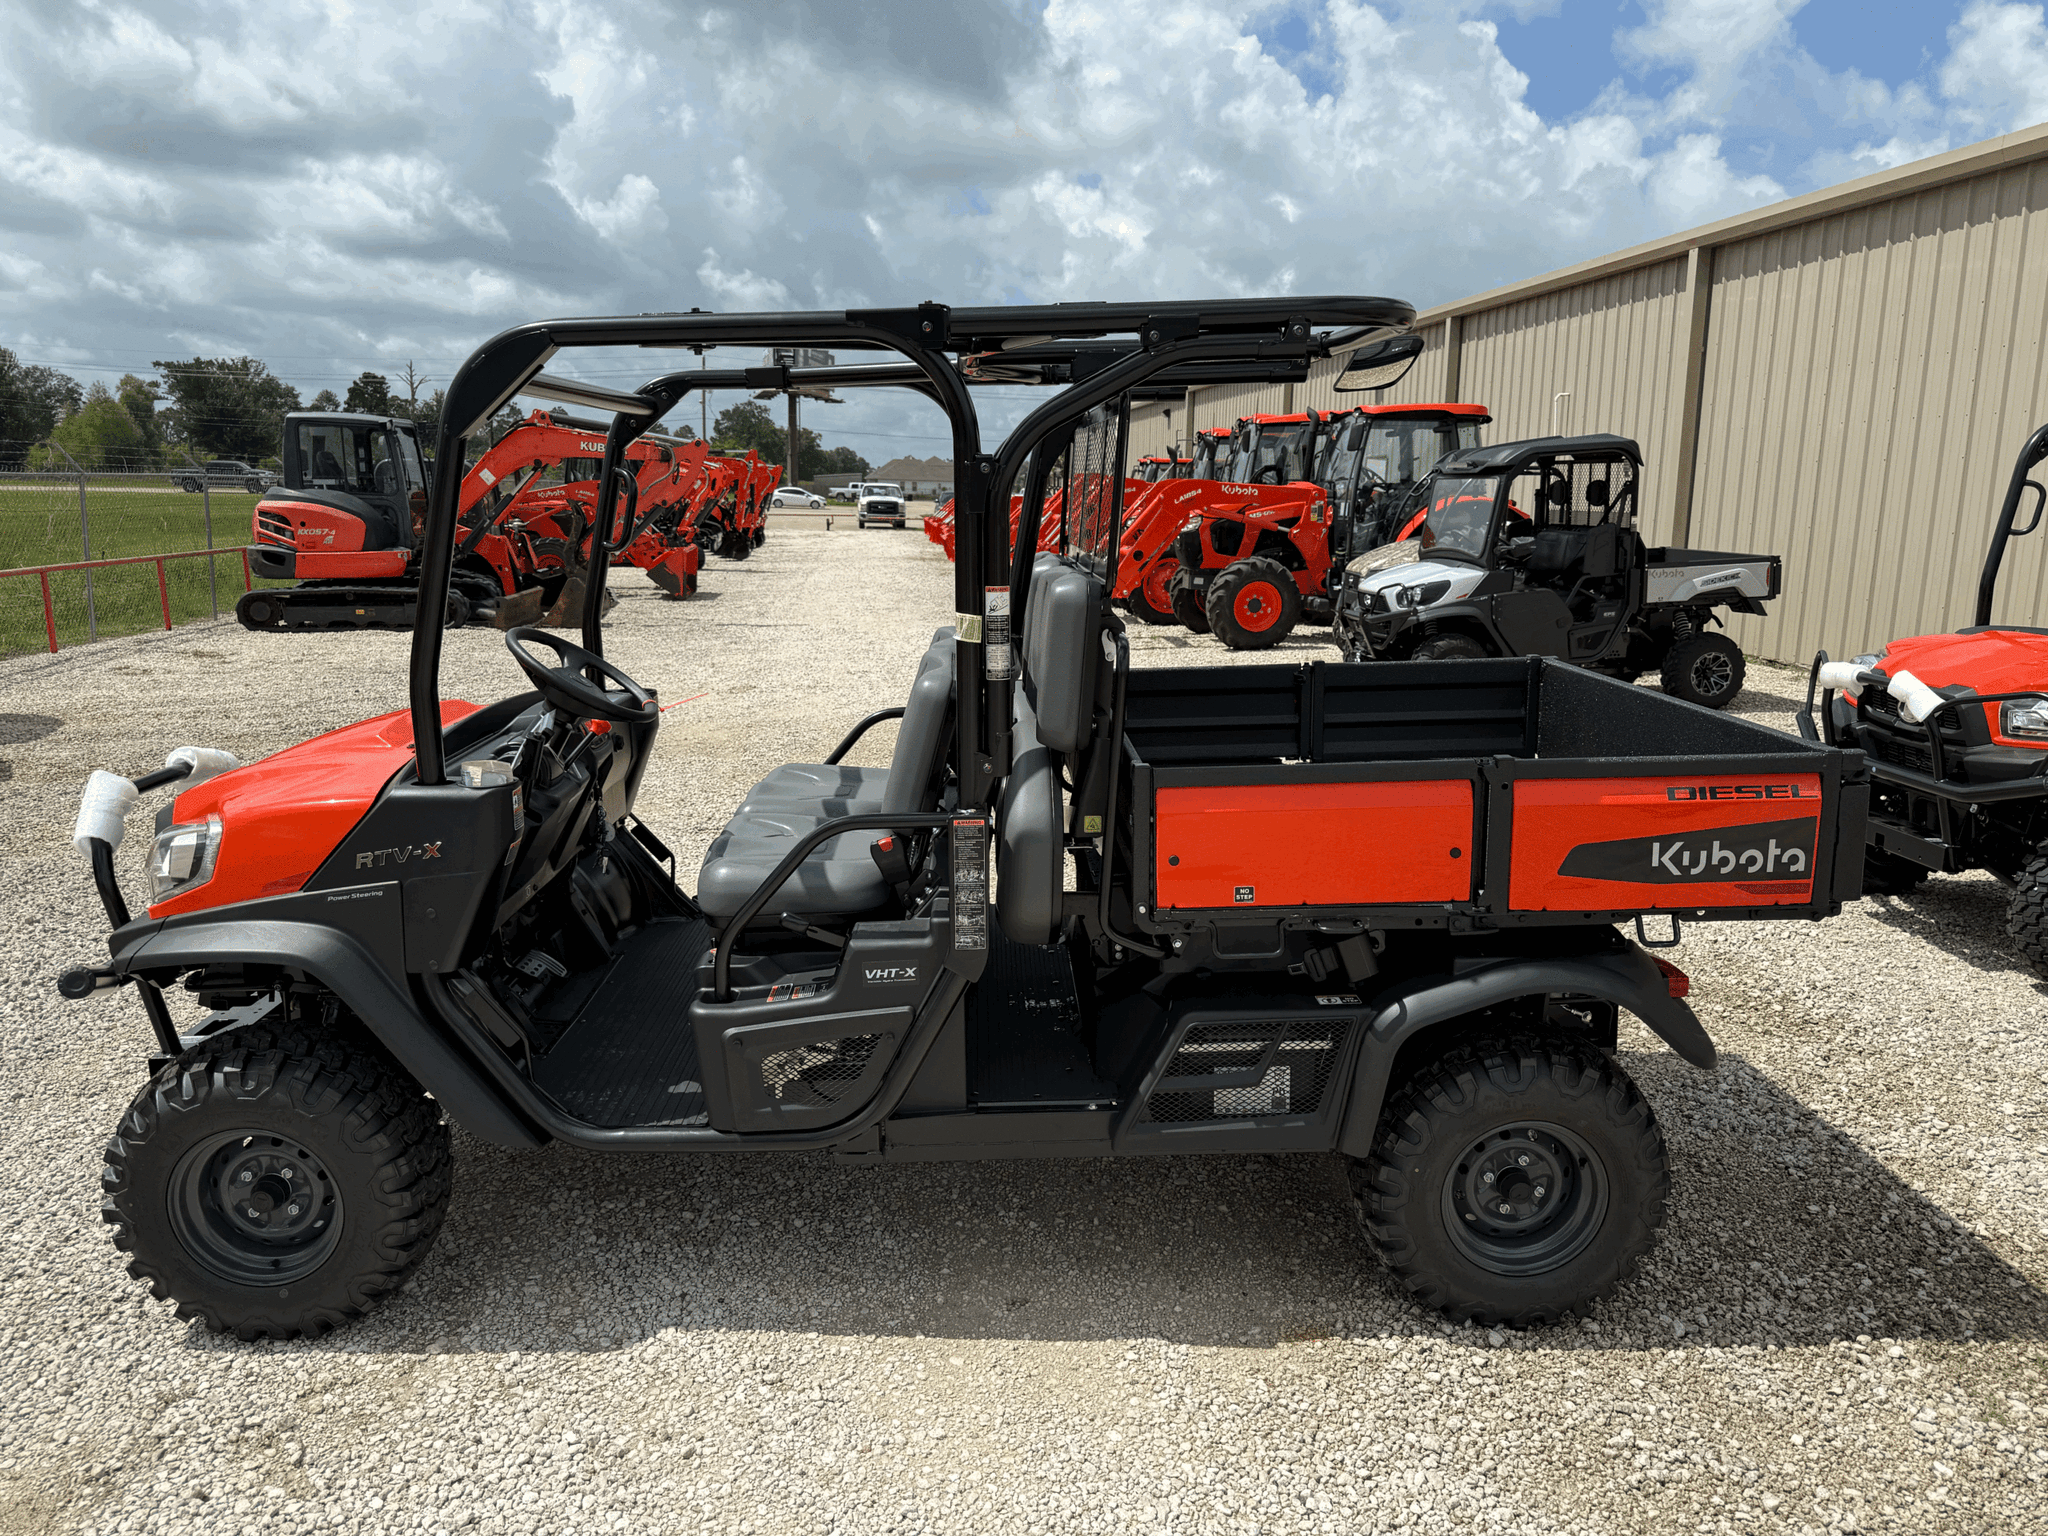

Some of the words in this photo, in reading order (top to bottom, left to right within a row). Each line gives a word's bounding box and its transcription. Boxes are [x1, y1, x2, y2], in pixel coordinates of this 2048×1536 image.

[580, 441, 606, 453] KUB
[1221, 485, 1259, 496] Kubota
[1648, 568, 1685, 579] Kubota
[1666, 784, 1819, 801] DIESEL
[355, 841, 442, 870] RTV-X
[1652, 838, 1806, 876] Kubota
[327, 894, 350, 902] Power
[351, 890, 383, 899] Steering
[865, 966, 917, 979] VHT-X
